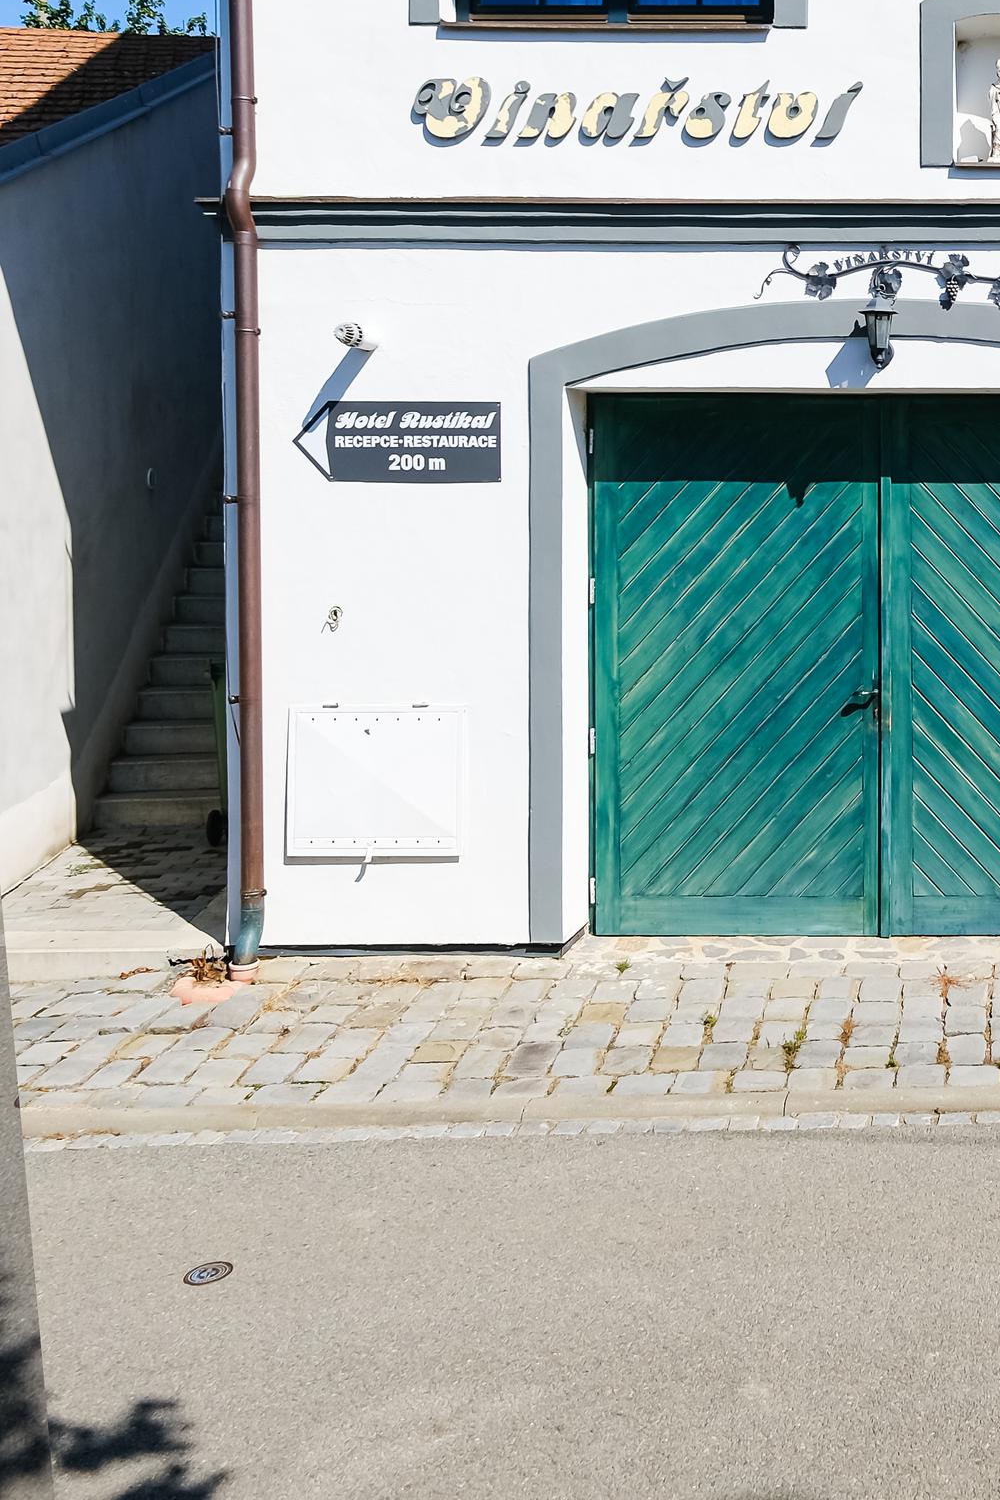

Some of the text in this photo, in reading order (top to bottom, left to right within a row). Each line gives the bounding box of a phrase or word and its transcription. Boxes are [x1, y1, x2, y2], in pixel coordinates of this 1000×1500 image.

[412, 76, 864, 140] Vinařství
[334, 411, 497, 429] Hotel Rustikal
[388, 454, 446, 471] 200 m
